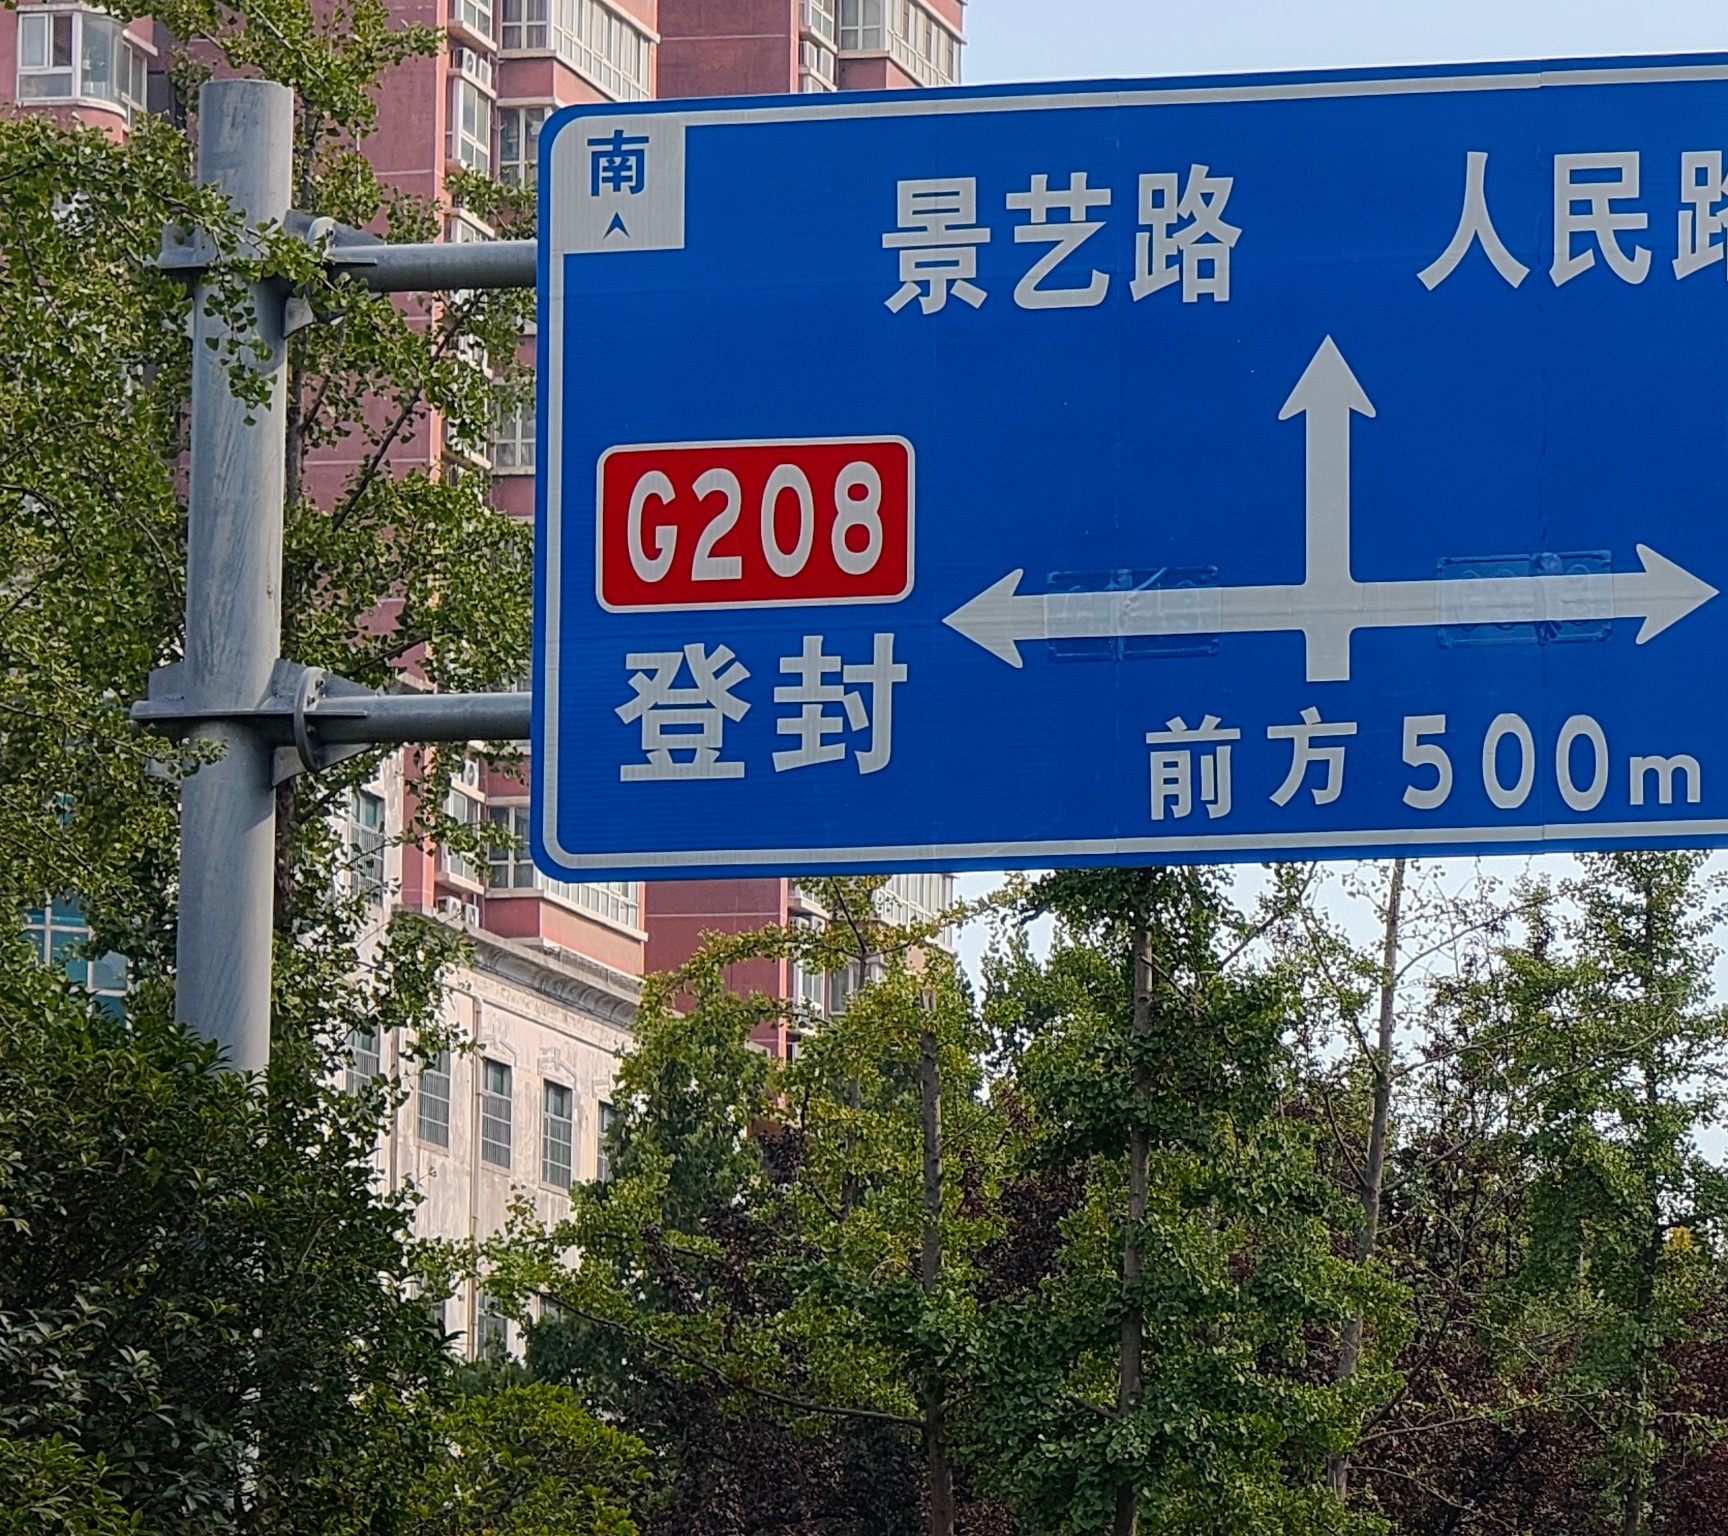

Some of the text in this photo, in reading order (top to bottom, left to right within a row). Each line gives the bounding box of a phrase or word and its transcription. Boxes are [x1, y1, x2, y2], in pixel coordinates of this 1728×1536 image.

[587, 130, 649, 196] 南
[882, 164, 1242, 315] 景艺路
[627, 461, 883, 583] G208
[616, 634, 908, 782] 登封
